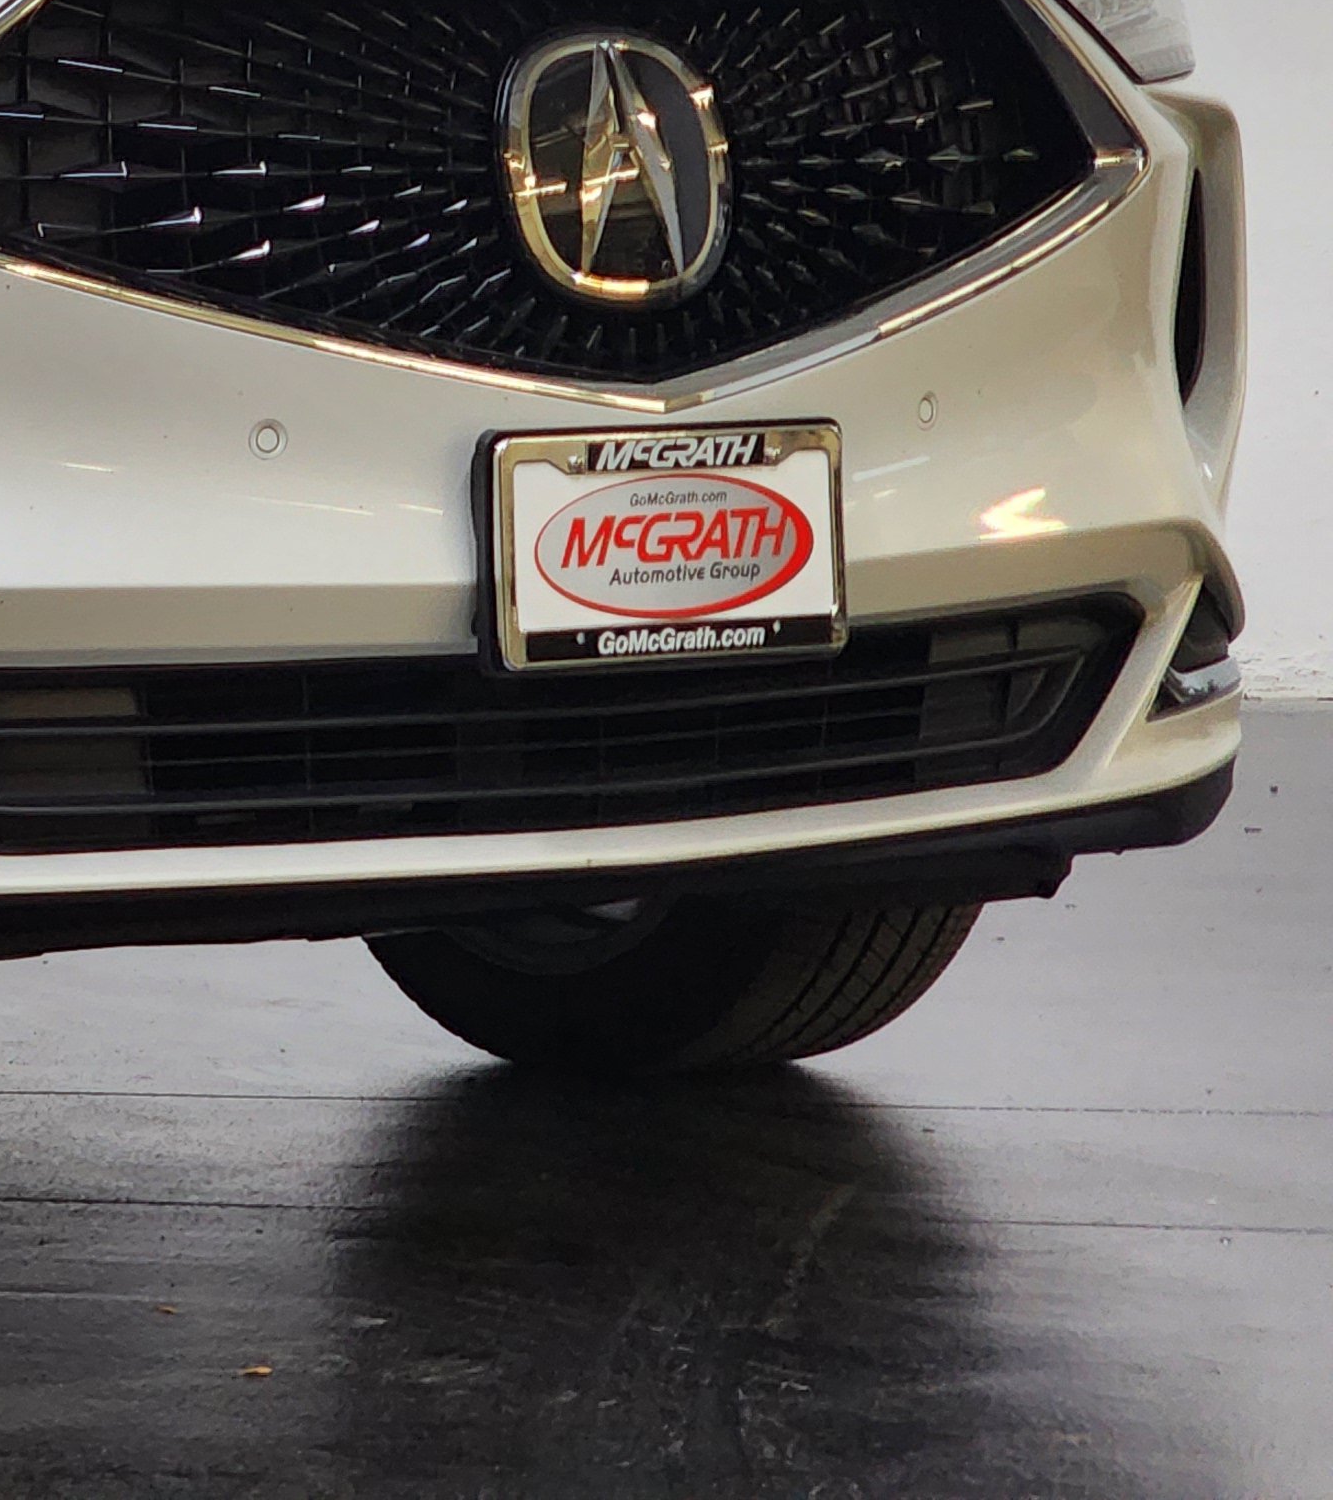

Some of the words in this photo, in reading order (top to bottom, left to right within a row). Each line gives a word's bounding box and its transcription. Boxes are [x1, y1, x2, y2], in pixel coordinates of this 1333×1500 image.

[629, 490, 728, 507] GoMcGrath.com
[609, 564, 705, 587] Automotive
[709, 561, 761, 582] Group
[598, 624, 765, 656] GoMcGrath.com
